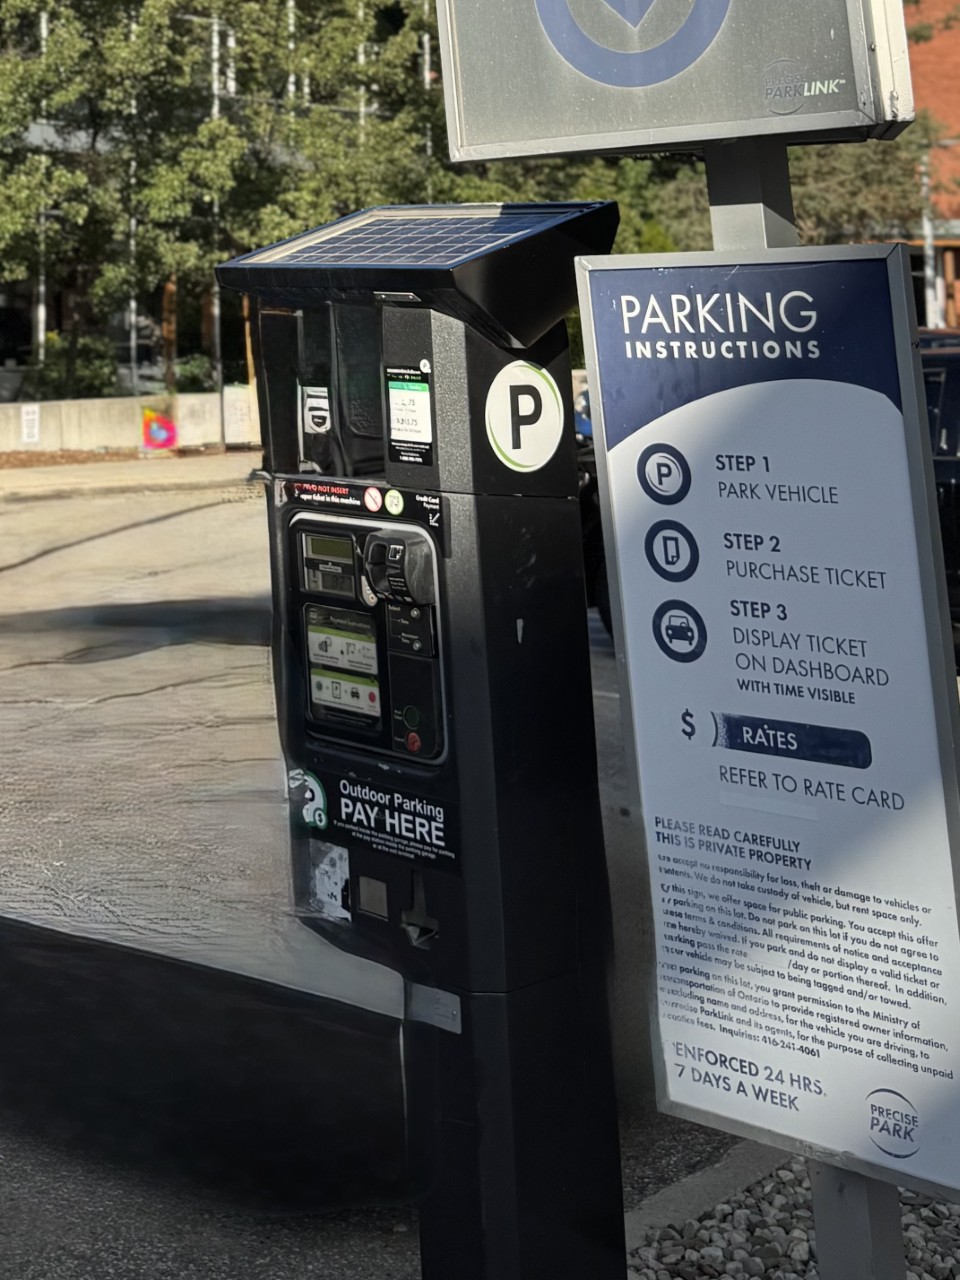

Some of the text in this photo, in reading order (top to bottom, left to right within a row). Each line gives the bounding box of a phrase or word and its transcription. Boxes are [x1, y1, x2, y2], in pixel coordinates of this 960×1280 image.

[621, 291, 816, 333] PARKING
[625, 341, 819, 358] INSTRUCTIONS
[509, 385, 542, 449] P
[716, 454, 769, 472] STEP 1
[718, 481, 838, 504] PARK VEHICLE
[724, 533, 781, 552] STEP 2
[726, 560, 886, 589] PURCHASE TICKET
[730, 600, 787, 621] STEP 3
[733, 627, 867, 657] DISPLAY TICKET
[736, 653, 889, 689] ON DASHBOARD
[737, 678, 855, 704] WITH TIME VISIBLE
[681, 708, 797, 750] $ RATES
[340, 780, 444, 824] Outdoor Parking
[719, 765, 904, 810] REFER TO RATE CARD
[341, 795, 380, 829] PAY
[383, 807, 445, 848] HERE
[655, 816, 800, 853] PLEASE READ CAREFULLY
[656, 831, 811, 870] THIS IS PRIVATE PROPERTY
[800, 880, 932, 914] theft or damage to vehicles or
[801, 894, 924, 927] vehicle, but rent space only.
[782, 908, 938, 947] public parking. You accept this offer
[812, 925, 939, 961] this lot if you do not agree to
[774, 932, 942, 976] requirements of notice and acceptance
[806, 950, 819, 961] do
[820, 955, 835, 964] not
[836, 957, 869, 974] display
[878, 968, 902, 980] valid
[903, 973, 928, 986] ticket
[929, 981, 940, 989] or
[787, 971, 911, 1009] being tagged and/or towed.
[822, 969, 854, 982] portion
[855, 975, 891, 990] thereof.
[894, 984, 904, 994] In
[906, 988, 947, 1004] addition,
[781, 1003, 948, 1050] provide registered owner information,
[797, 994, 920, 1030] permission to the Ministry of
[796, 1030, 954, 1080] for the purpose of collecting unpaid
[799, 1019, 930, 1059] the vehicle you are driving, to
[672, 1042, 827, 1096] ENFORCED 24 HRS.
[674, 1063, 801, 1111] 7 DAYS A WEEK
[870, 1104, 918, 1128] PRECISE
[870, 1117, 915, 1143] PARK
